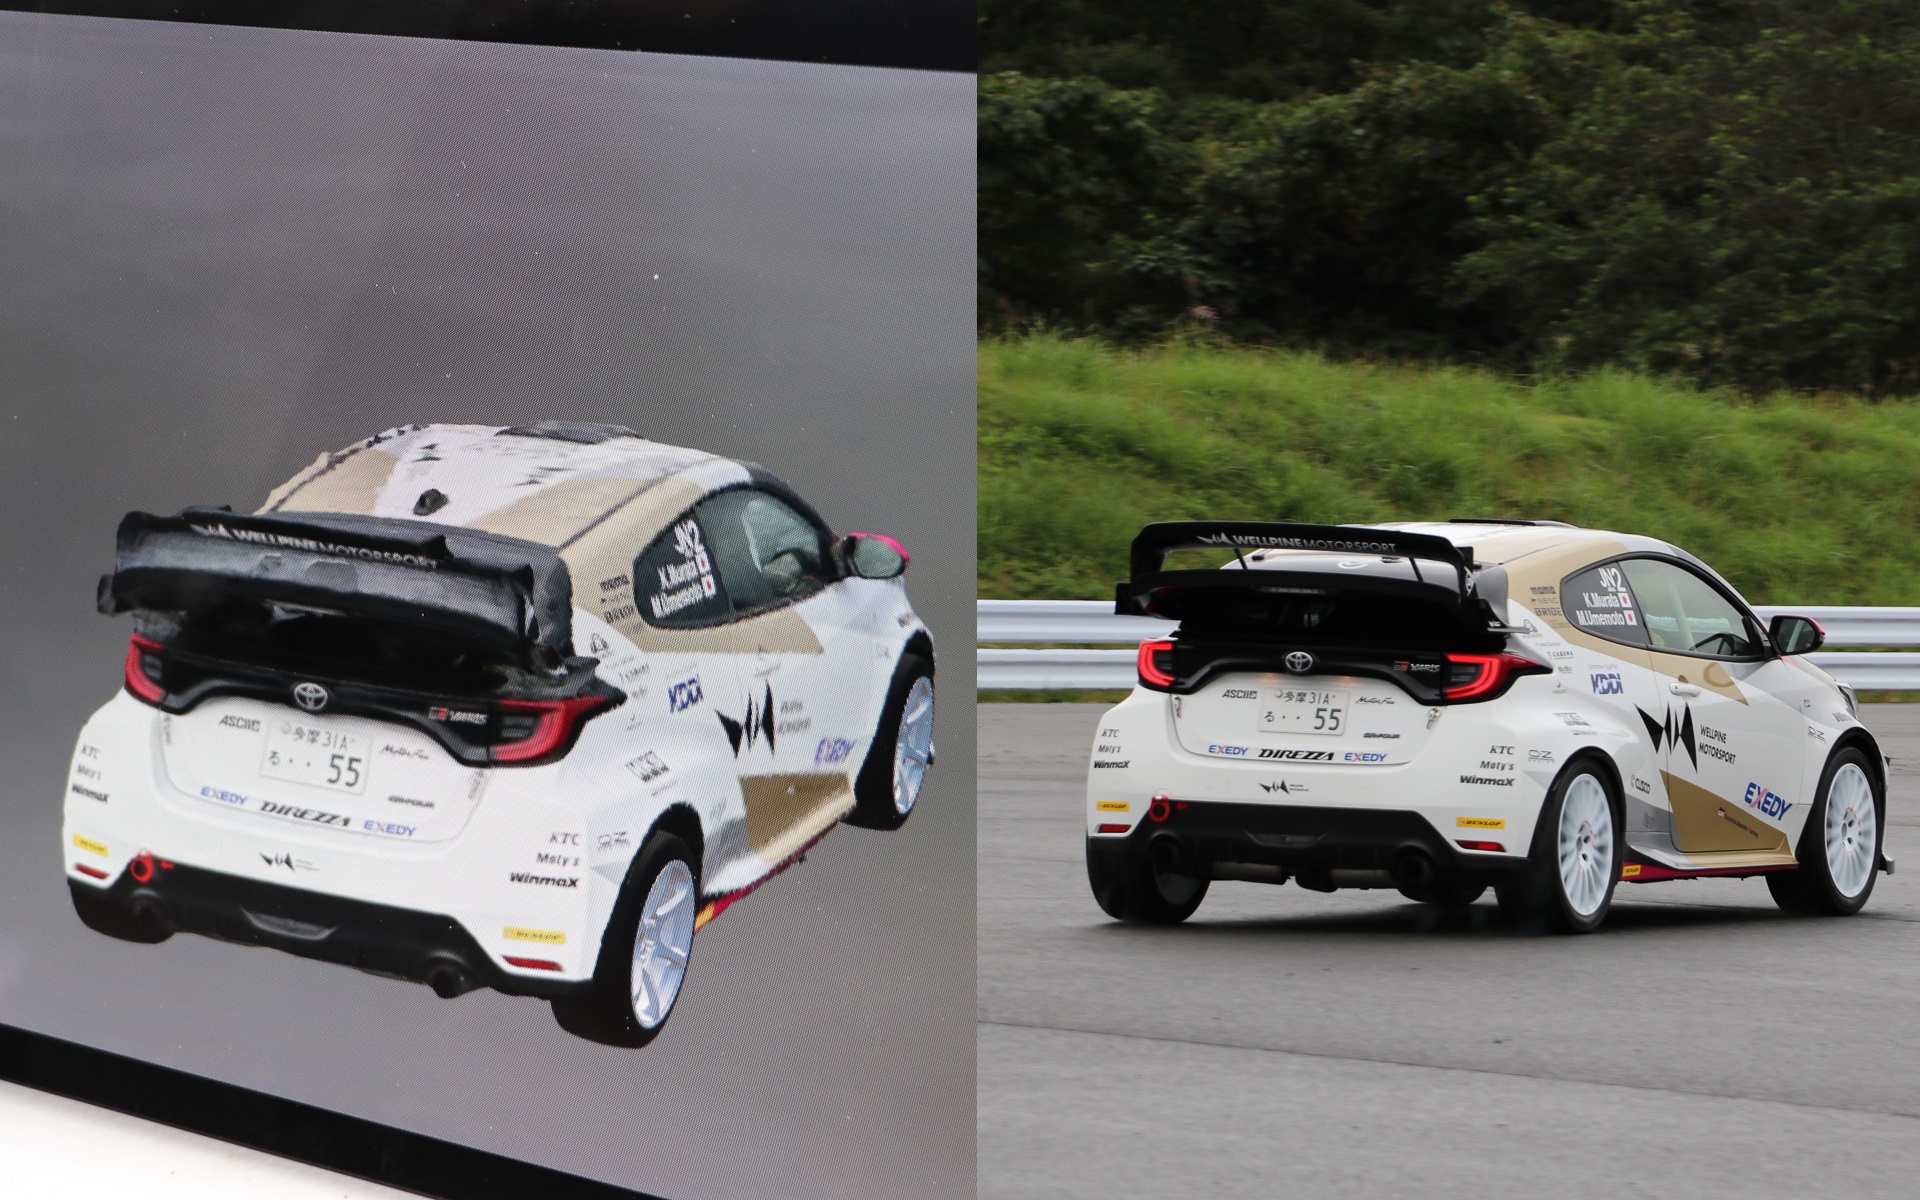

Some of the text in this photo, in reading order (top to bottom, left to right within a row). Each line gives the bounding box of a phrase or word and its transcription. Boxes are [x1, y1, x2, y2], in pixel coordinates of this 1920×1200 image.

[1232, 534, 1396, 553] WELLPINE MOTORSPORT
[1598, 567, 1627, 592] JN2
[1533, 607, 1563, 617] BRIDE
[1590, 673, 1624, 695] KDDI
[1313, 707, 1342, 731] 55
[1101, 728, 1120, 738] KTC
[1700, 724, 1727, 744] WELLPINE
[1208, 744, 1249, 756] EXEDY
[1258, 748, 1335, 761] DIREZZA
[1344, 752, 1388, 762] EXEDY
[1489, 745, 1515, 755] KTC
[1698, 742, 1736, 765] MOTORSPORT
[327, 754, 363, 788] 55
[200, 785, 248, 806] EXEDY
[1744, 781, 1793, 822] EXEDY
[261, 800, 352, 827] DIREZZA
[363, 819, 417, 837] EXEDY
[549, 832, 581, 847] KTC
